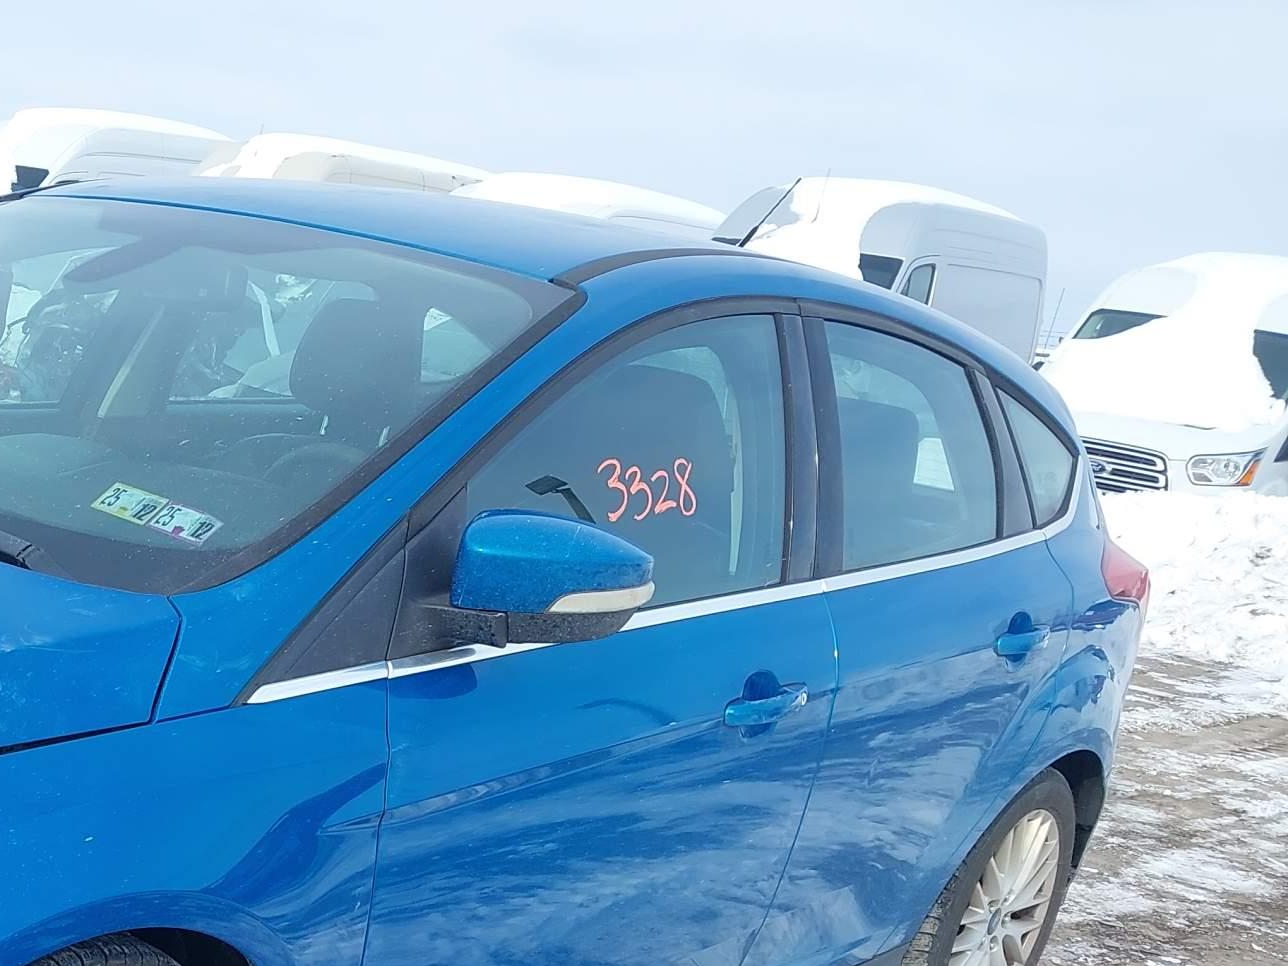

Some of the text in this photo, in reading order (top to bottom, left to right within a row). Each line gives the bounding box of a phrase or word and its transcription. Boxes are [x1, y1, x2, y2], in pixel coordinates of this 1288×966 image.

[101, 487, 158, 522] 25 12
[597, 458, 697, 522] 3328
[155, 506, 215, 540] 25 12
